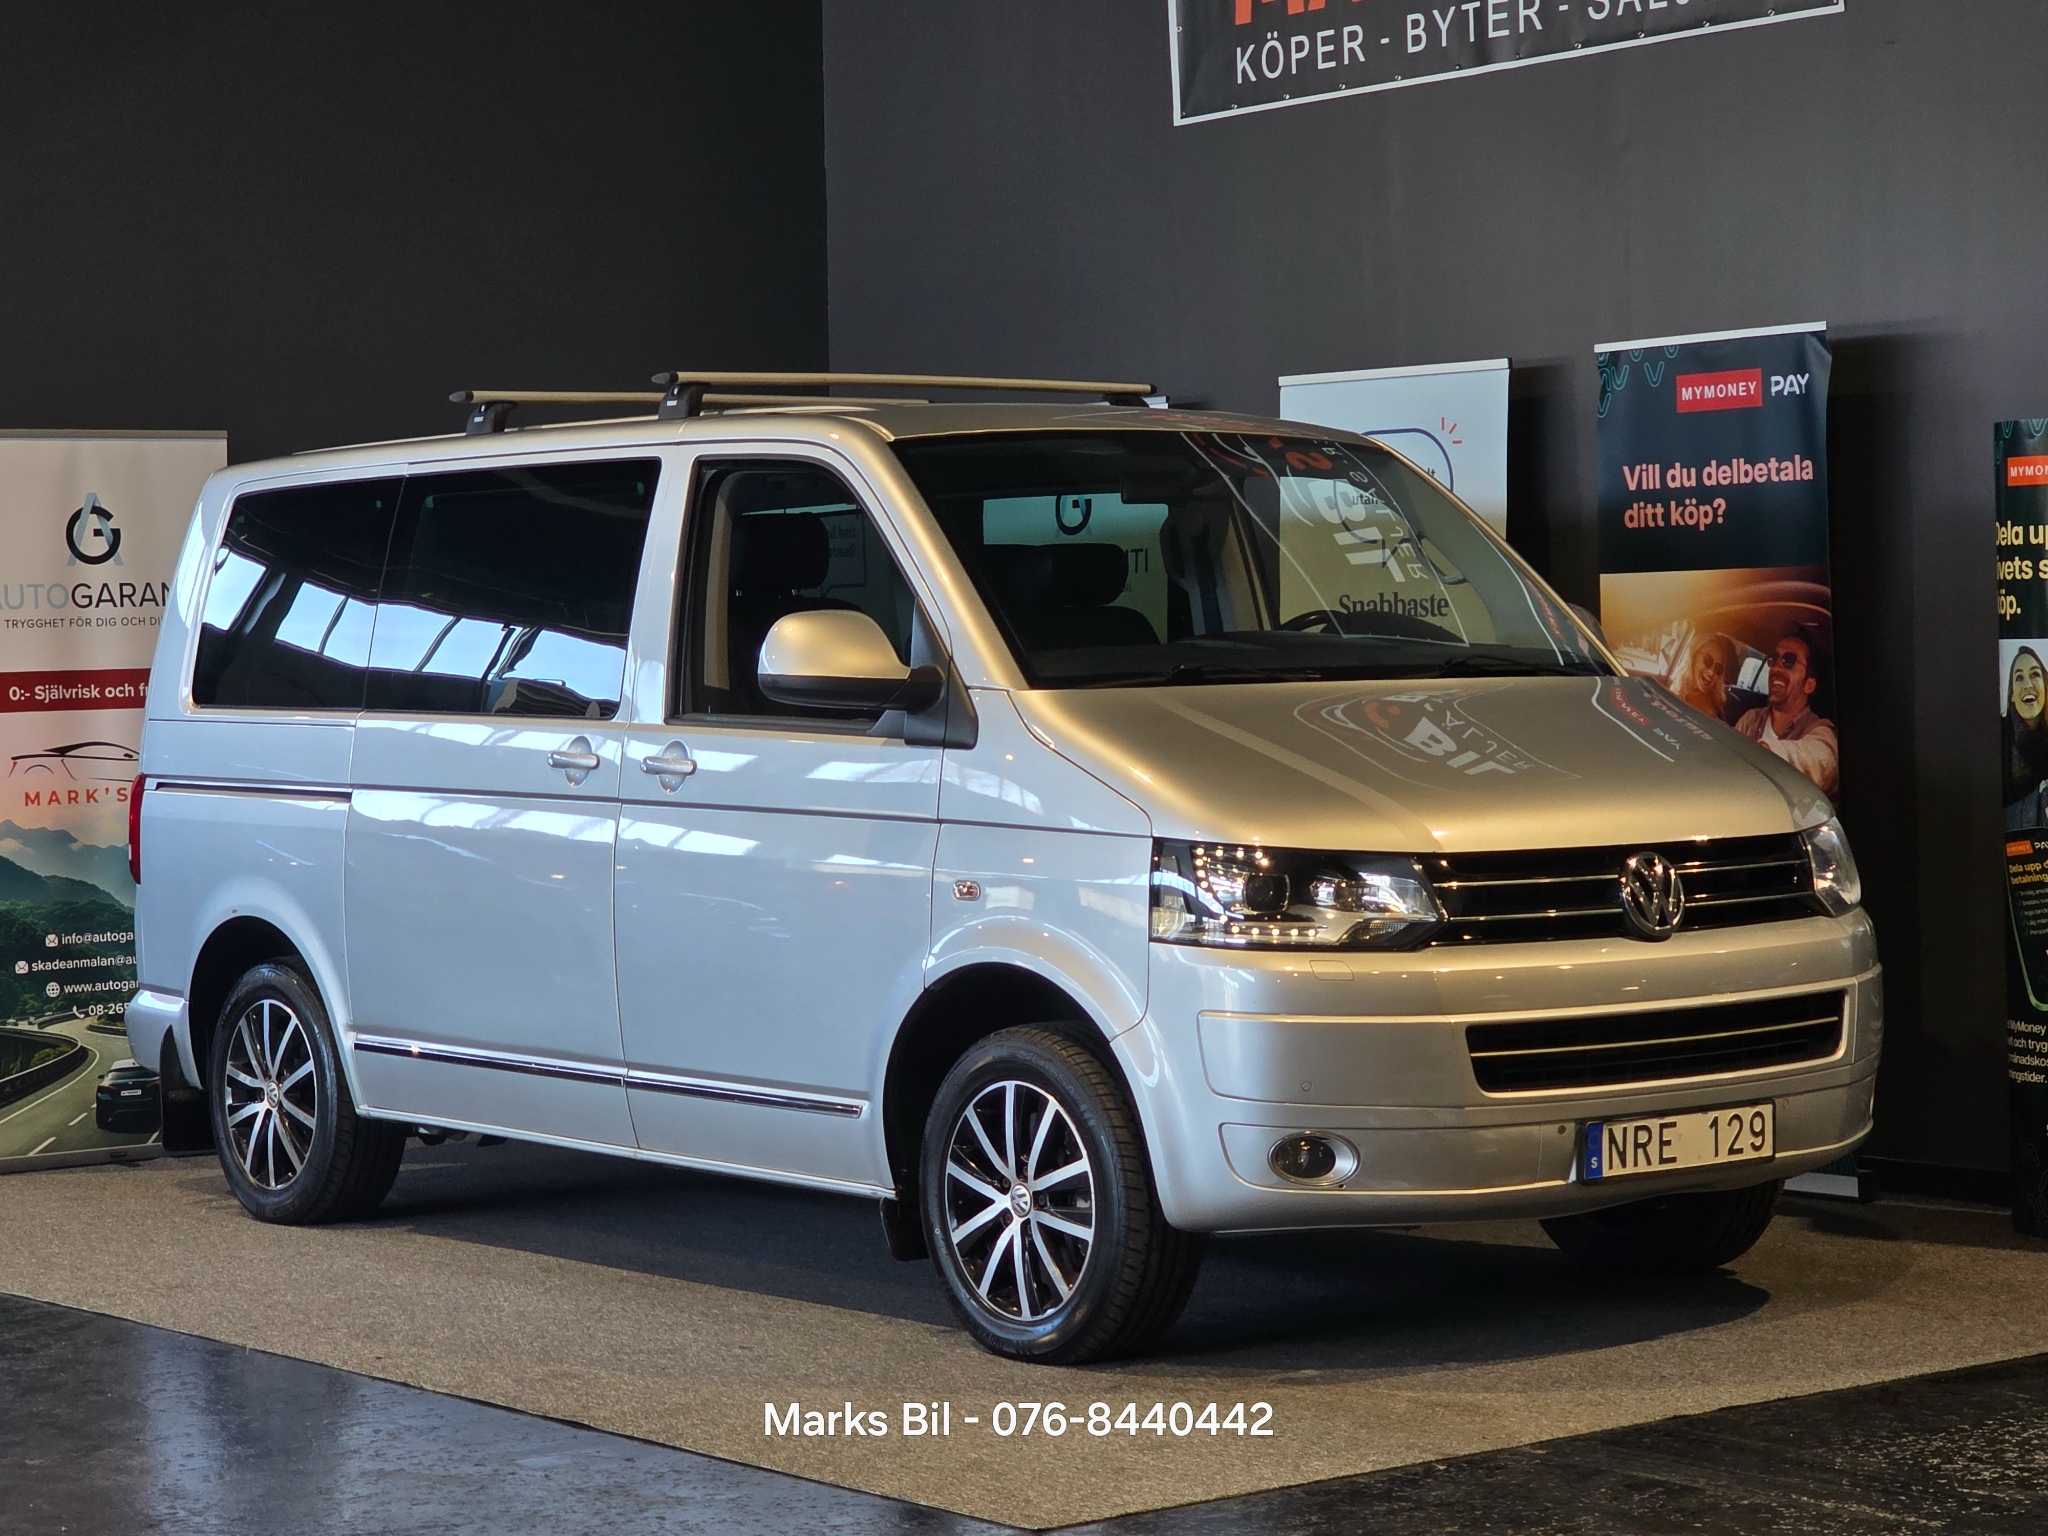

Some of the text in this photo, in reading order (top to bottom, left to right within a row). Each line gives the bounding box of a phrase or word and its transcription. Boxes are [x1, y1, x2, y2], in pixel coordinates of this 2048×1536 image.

[1236, 24, 1366, 84] KÖPER
[1406, 0, 1543, 54] BYTER
[1681, 373, 1810, 400] MYMONEY PAY
[1623, 454, 1814, 491] Vill du delbetala
[1624, 497, 1727, 531] ditt köp?
[5, 616, 163, 629] TRYGGHET FÖR DIG OCH DI
[8, 686, 31, 701] 0:-
[34, 683, 101, 703] Självrisk
[104, 683, 135, 698] och
[24, 787, 128, 806] MARK'S
[2024, 862, 2042, 872] upp
[61, 931, 134, 945] info@autoga
[2013, 1037, 2027, 1049] och
[1608, 1110, 1766, 1170] NRE 129
[1591, 1156, 1598, 1169] S
